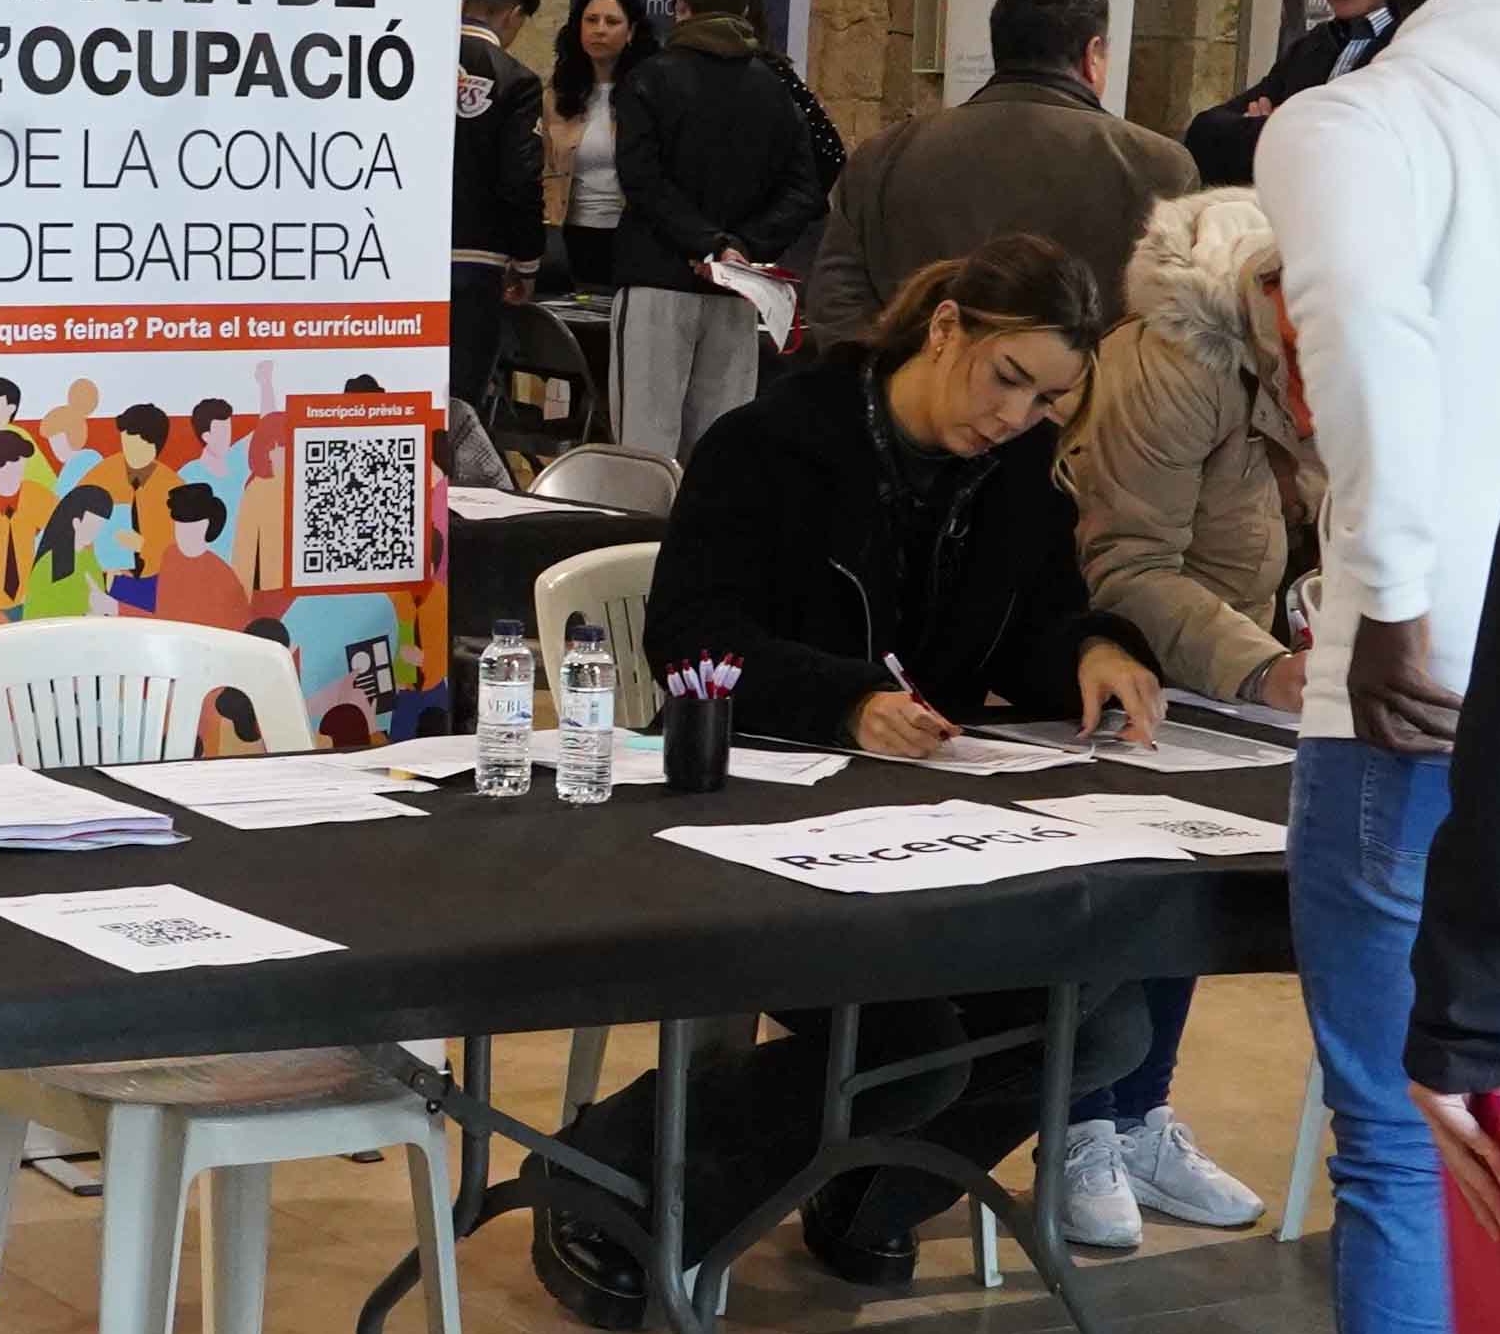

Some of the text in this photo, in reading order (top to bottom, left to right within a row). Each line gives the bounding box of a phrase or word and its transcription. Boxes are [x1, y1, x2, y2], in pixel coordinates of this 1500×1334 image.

[83, 129, 159, 189] LA
[178, 130, 403, 190] CONCA
[95, 207, 391, 282] BARBERÀ
[63, 317, 138, 340] feina?
[146, 316, 212, 339] Porta
[219, 316, 241, 339] el
[246, 317, 286, 338] teu
[293, 313, 422, 337] currículum!
[306, 405, 365, 419] Inscripció
[772, 826, 1078, 870] Recepció
